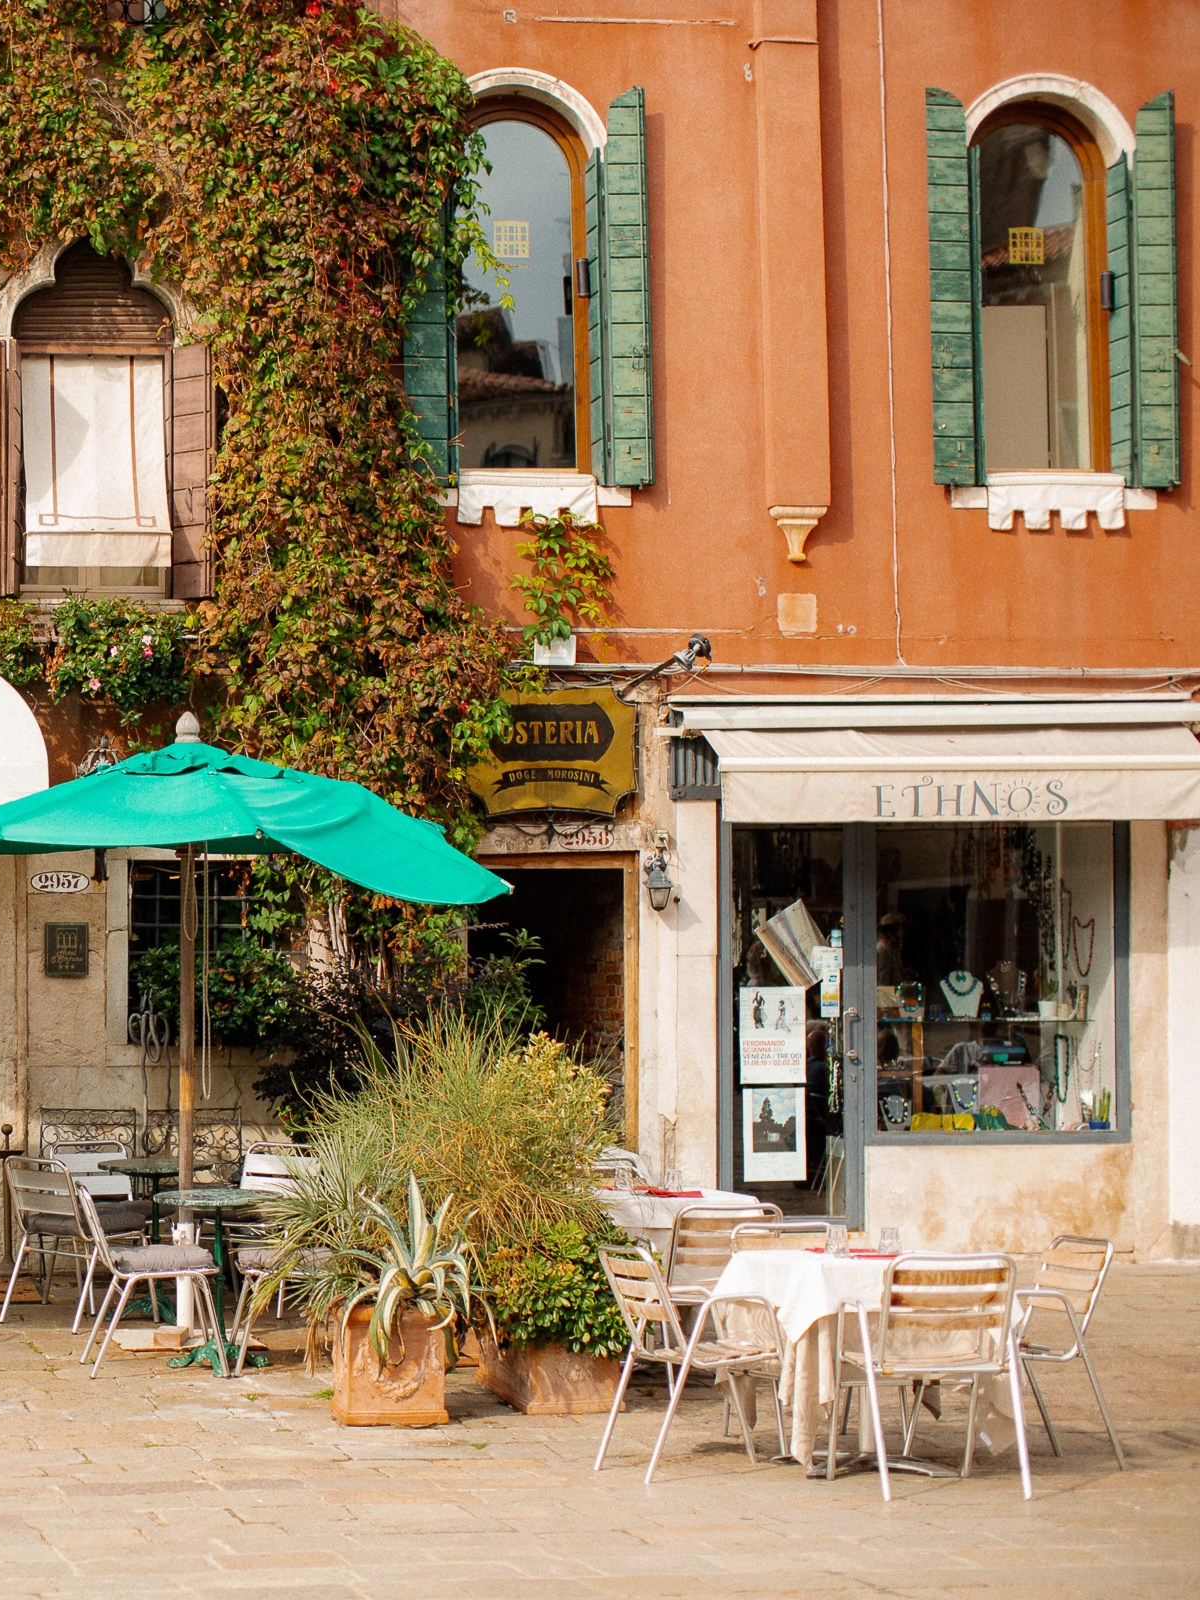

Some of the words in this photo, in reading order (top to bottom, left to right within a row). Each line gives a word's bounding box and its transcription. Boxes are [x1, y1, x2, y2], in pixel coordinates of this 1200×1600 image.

[509, 770, 536, 782] DOGE
[547, 770, 595, 783] MOROSINI
[871, 775, 1069, 818] ETHNOS
[564, 830, 610, 846] 2958
[38, 874, 82, 889] 2957
